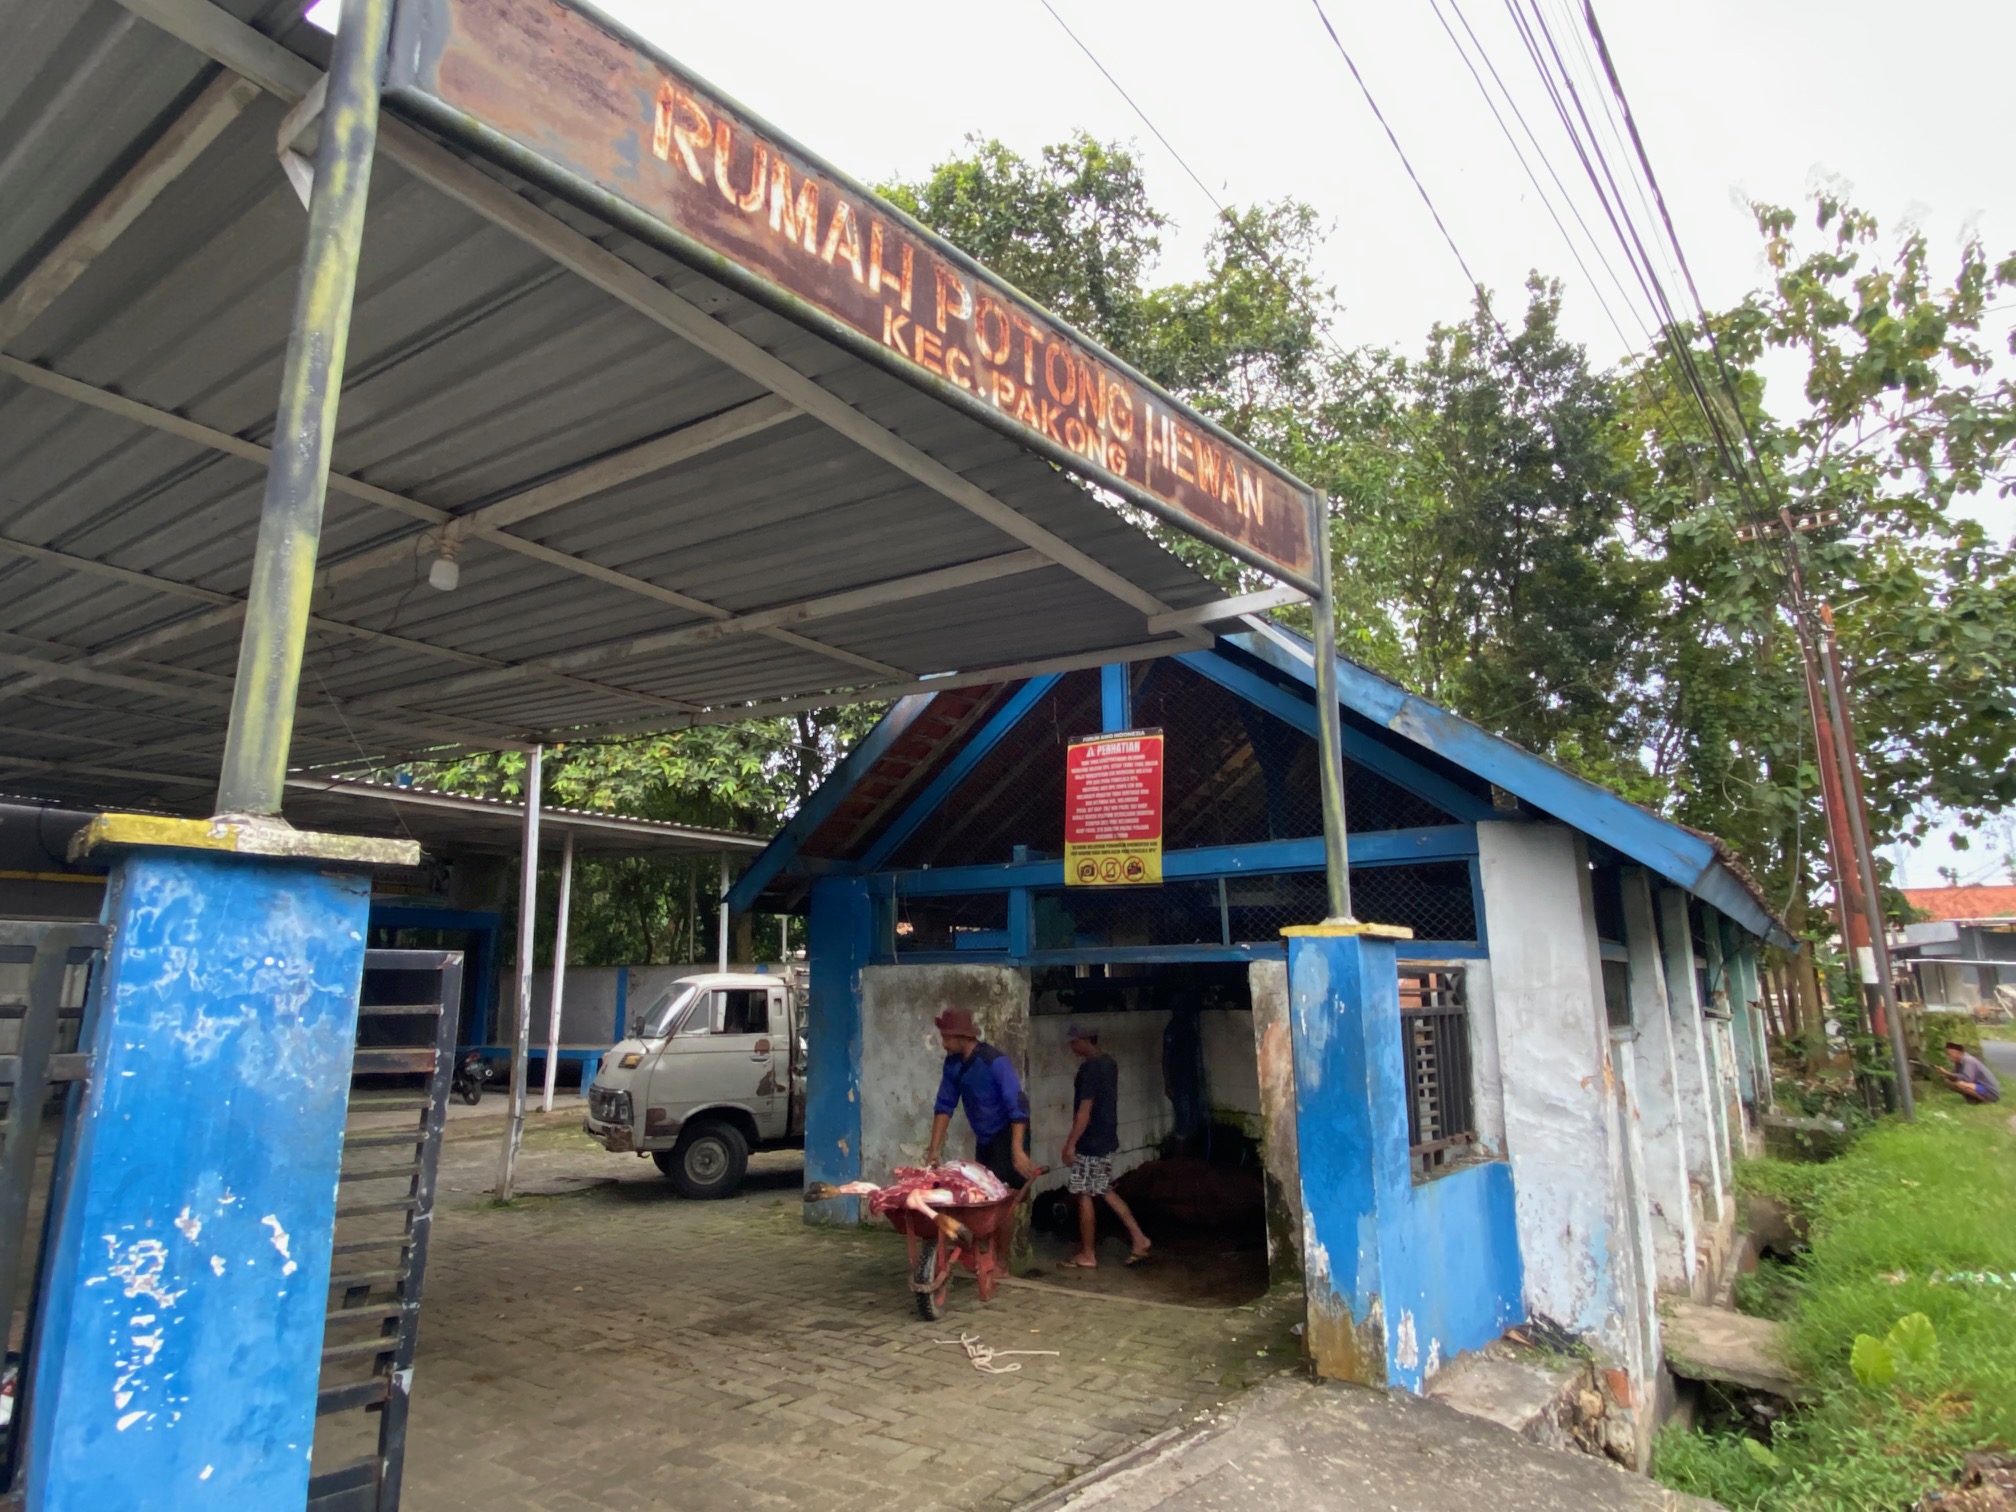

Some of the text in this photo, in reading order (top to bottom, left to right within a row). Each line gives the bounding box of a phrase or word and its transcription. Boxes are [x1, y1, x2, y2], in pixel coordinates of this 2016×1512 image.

[653, 79, 1264, 527] RUMAH POTONG HEWAN
[1097, 741, 1140, 757] PERHATIAN
